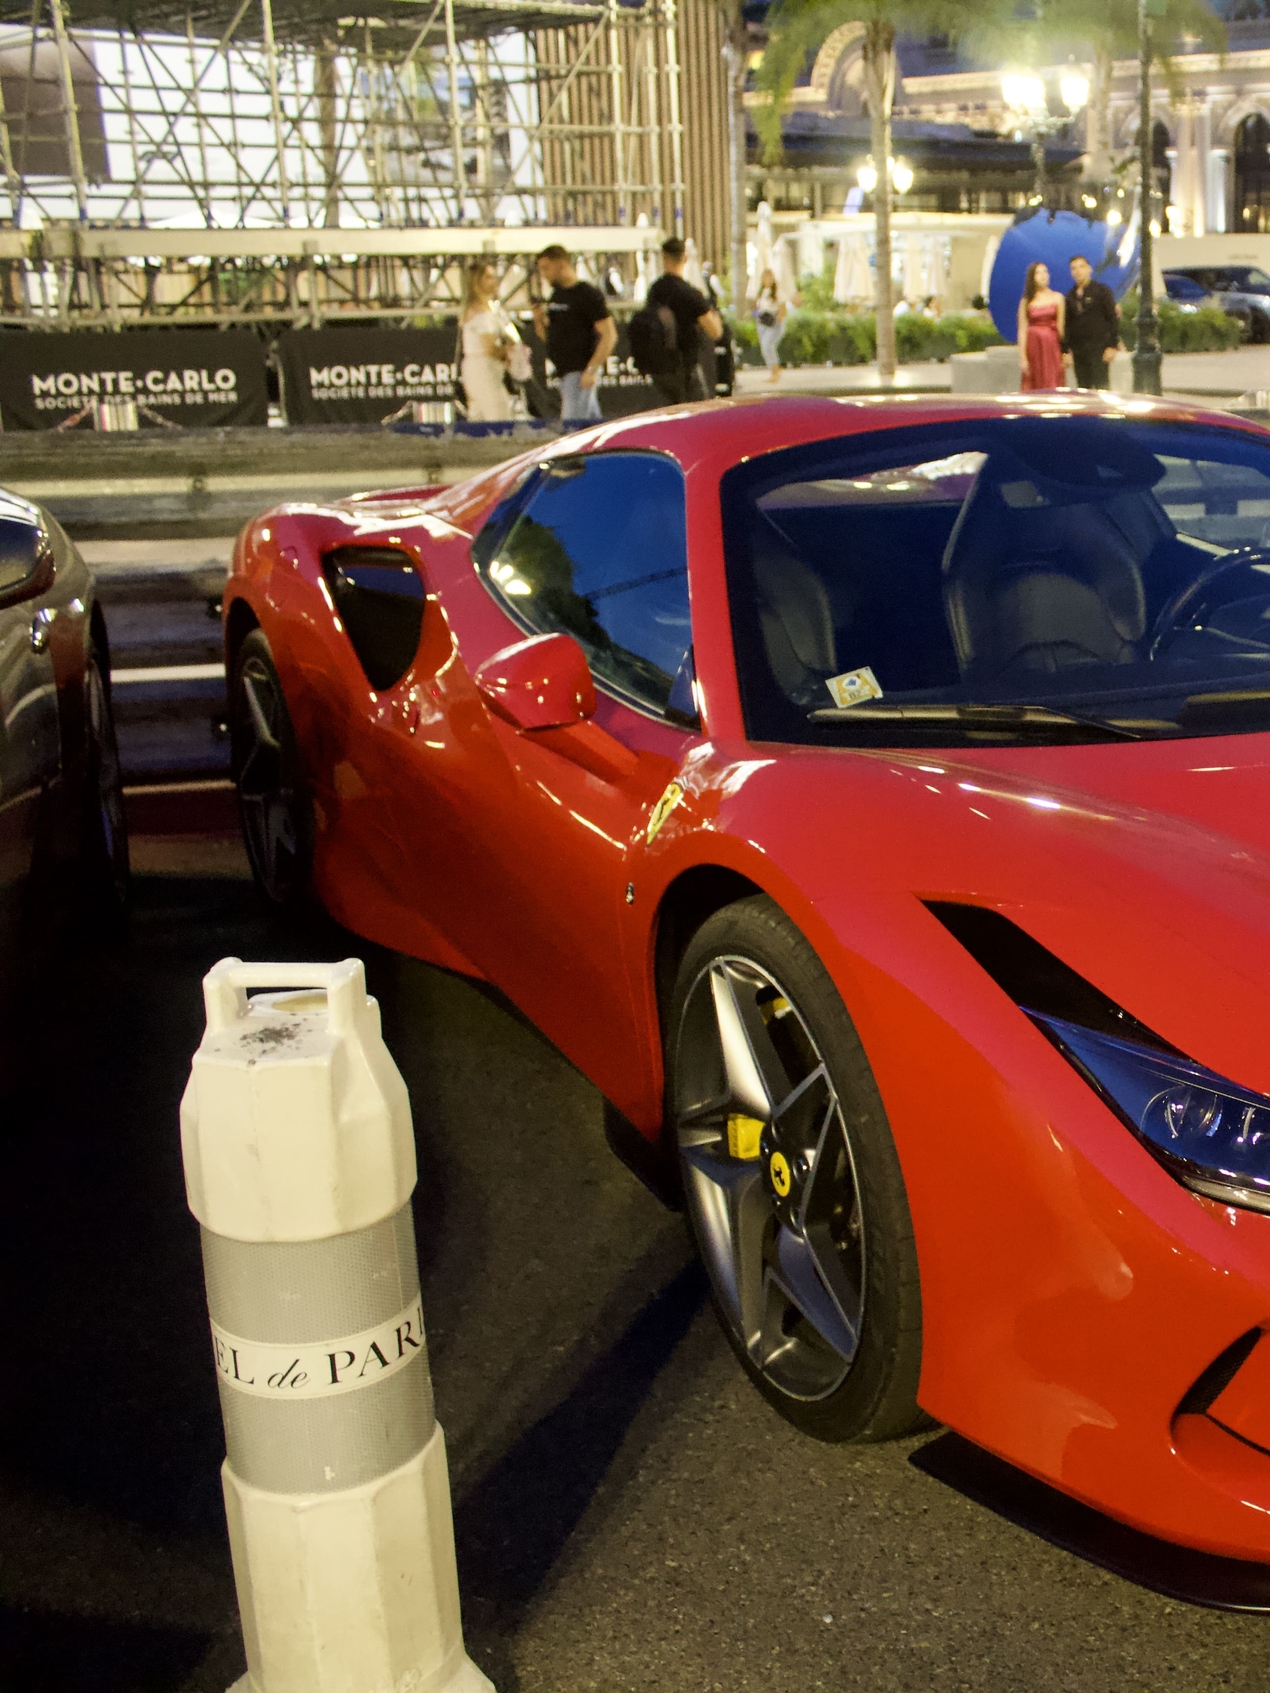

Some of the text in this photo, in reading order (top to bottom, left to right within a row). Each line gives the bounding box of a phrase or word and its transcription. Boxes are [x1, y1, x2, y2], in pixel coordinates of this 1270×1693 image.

[137, 392, 182, 406] BAINS
[185, 391, 204, 405] DE
[267, 1358, 310, 1389] de
